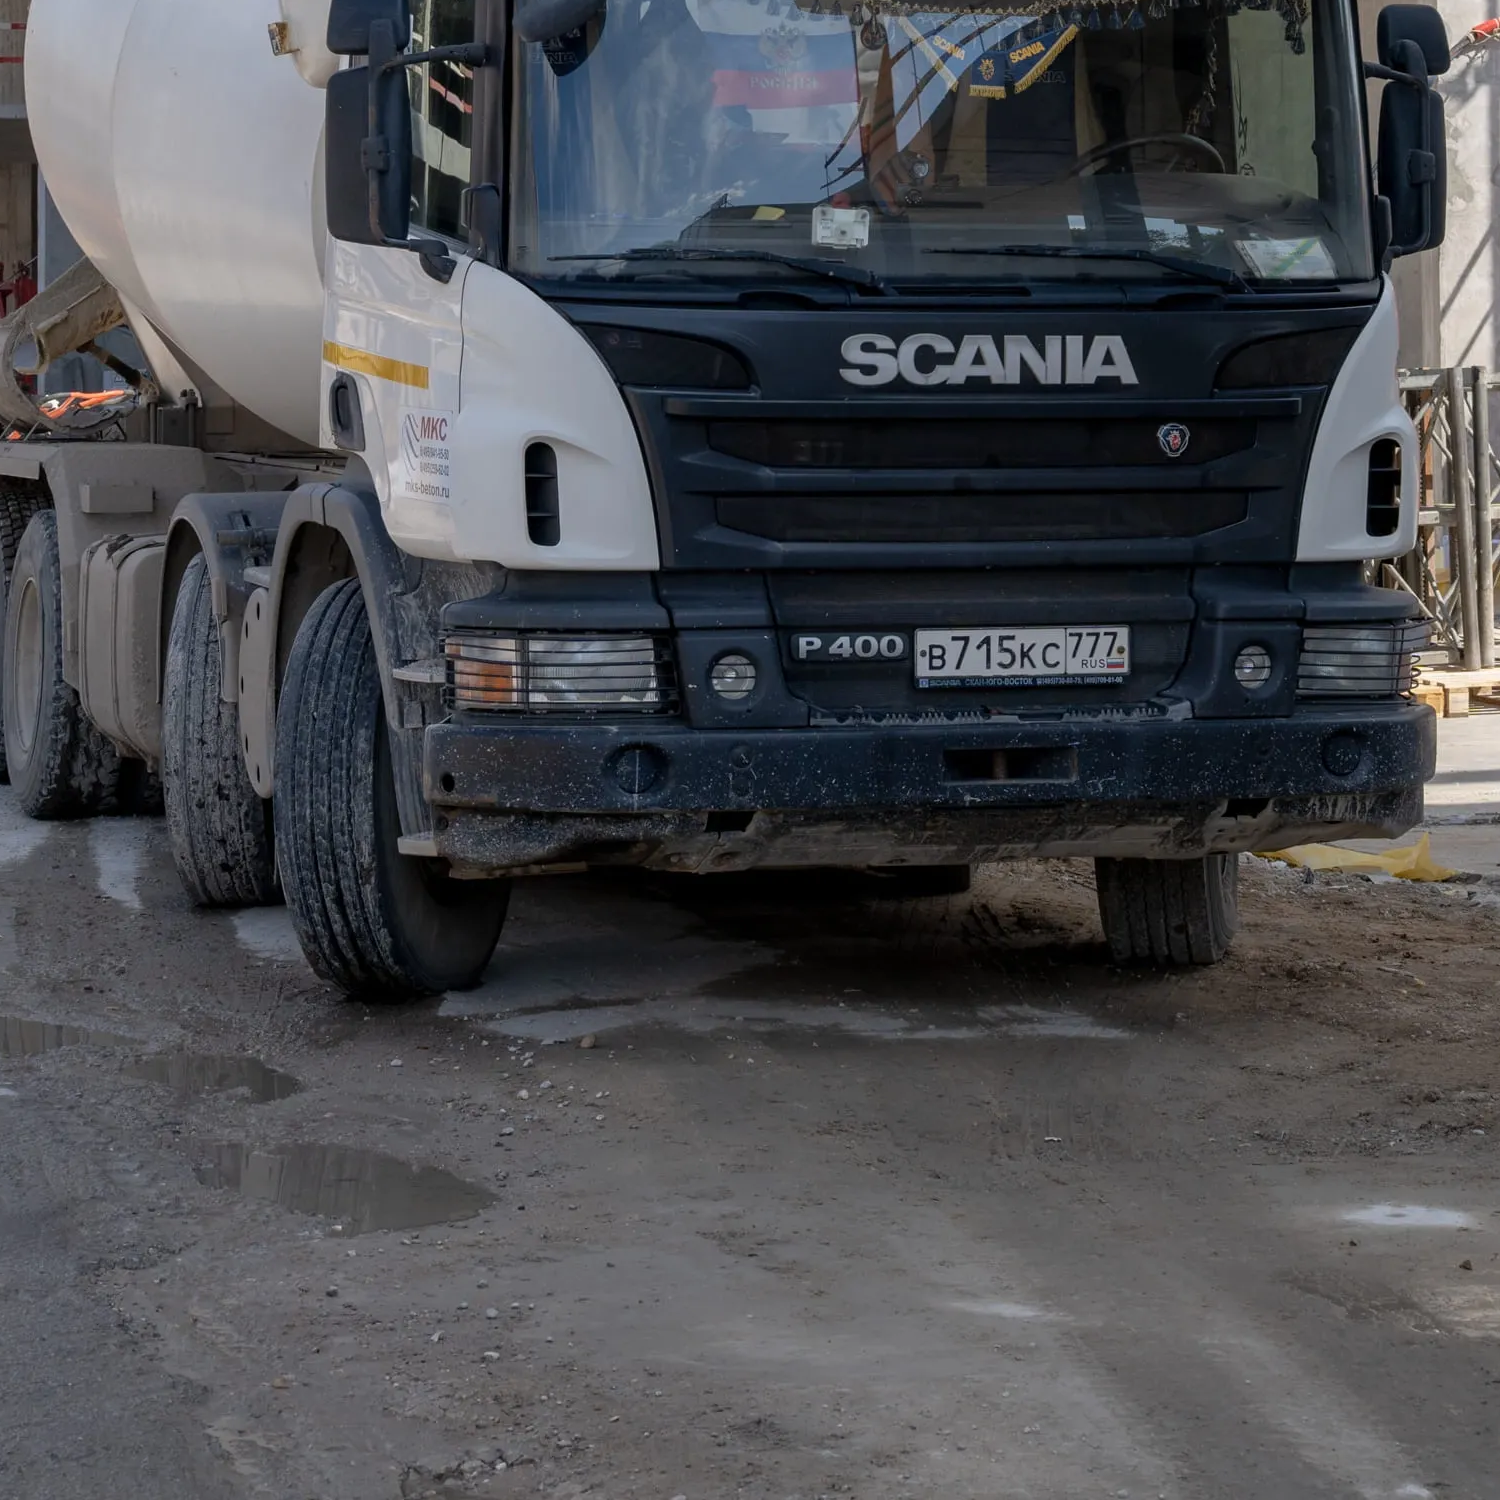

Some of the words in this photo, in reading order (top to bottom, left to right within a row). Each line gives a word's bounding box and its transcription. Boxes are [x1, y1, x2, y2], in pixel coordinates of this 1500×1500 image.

[932, 35, 966, 61] SCANIA
[1008, 41, 1046, 64] SCANIA
[750, 76, 819, 89] РОССИЯ
[839, 333, 1139, 385] SCANIA
[420, 416, 448, 442] МКС
[404, 478, 450, 498] mks-beton.ru
[799, 637, 822, 659] P
[828, 635, 904, 658] 400
[927, 634, 1061, 671] В715КС
[1068, 631, 1118, 659] 777
[1081, 658, 1106, 669] RUS
